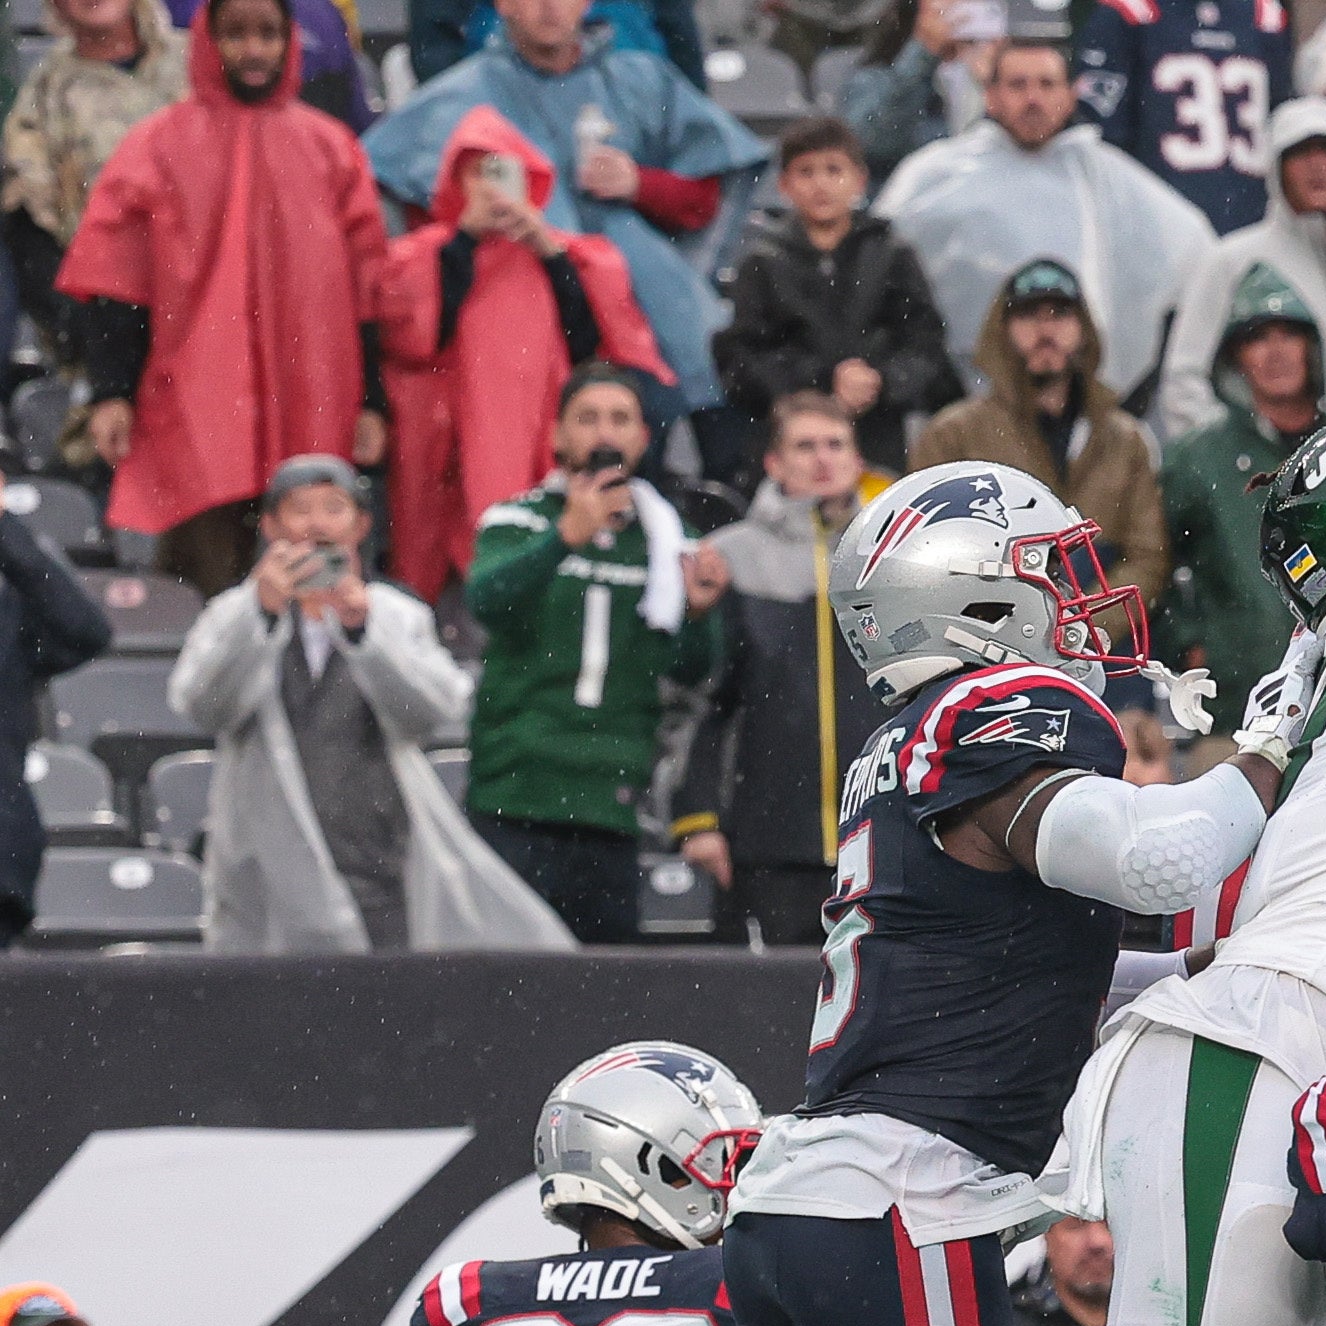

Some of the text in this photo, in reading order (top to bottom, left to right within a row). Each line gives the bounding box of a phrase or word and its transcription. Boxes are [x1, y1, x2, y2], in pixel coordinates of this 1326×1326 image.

[1152, 53, 1275, 176] 33
[574, 584, 612, 708] 1
[536, 1255, 674, 1302] WADE
